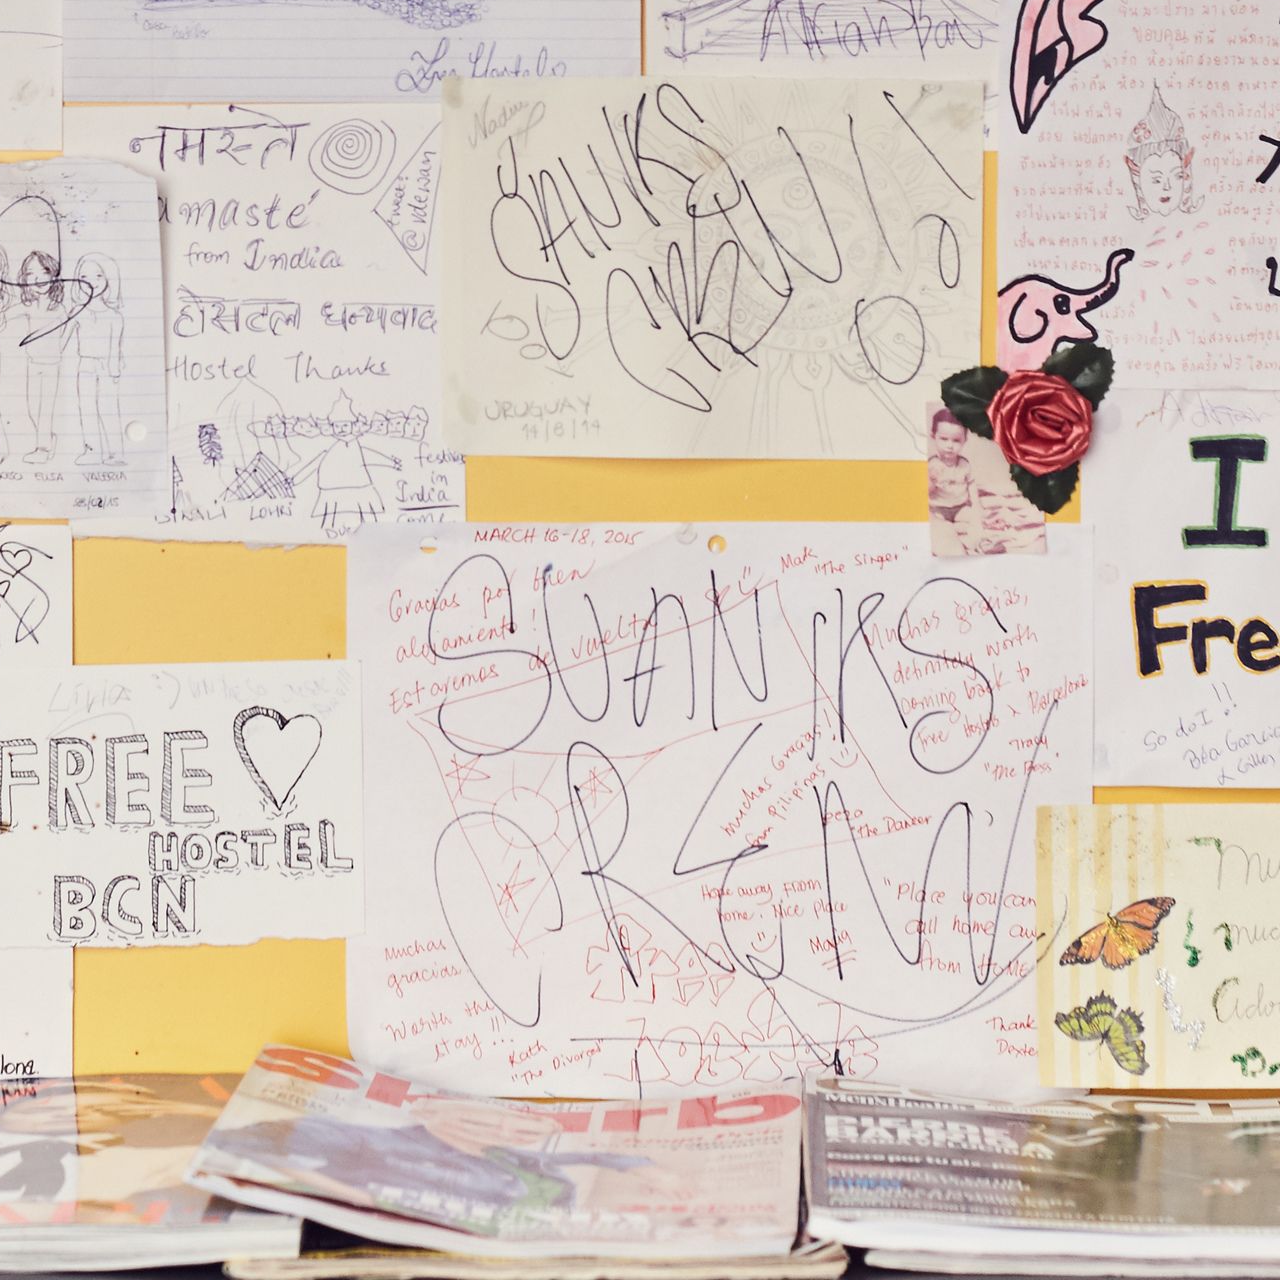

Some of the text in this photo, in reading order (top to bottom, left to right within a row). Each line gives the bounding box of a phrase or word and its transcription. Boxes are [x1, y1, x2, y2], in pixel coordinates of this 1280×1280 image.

[184, 242, 231, 269] from
[167, 354, 393, 384] Hostel Thanks
[1182, 434, 1270, 551] I
[474, 528, 536, 544] MARCH
[604, 530, 644, 546] 2015
[147, 819, 354, 874] HOSTEL
[50, 874, 199, 942] BCN
